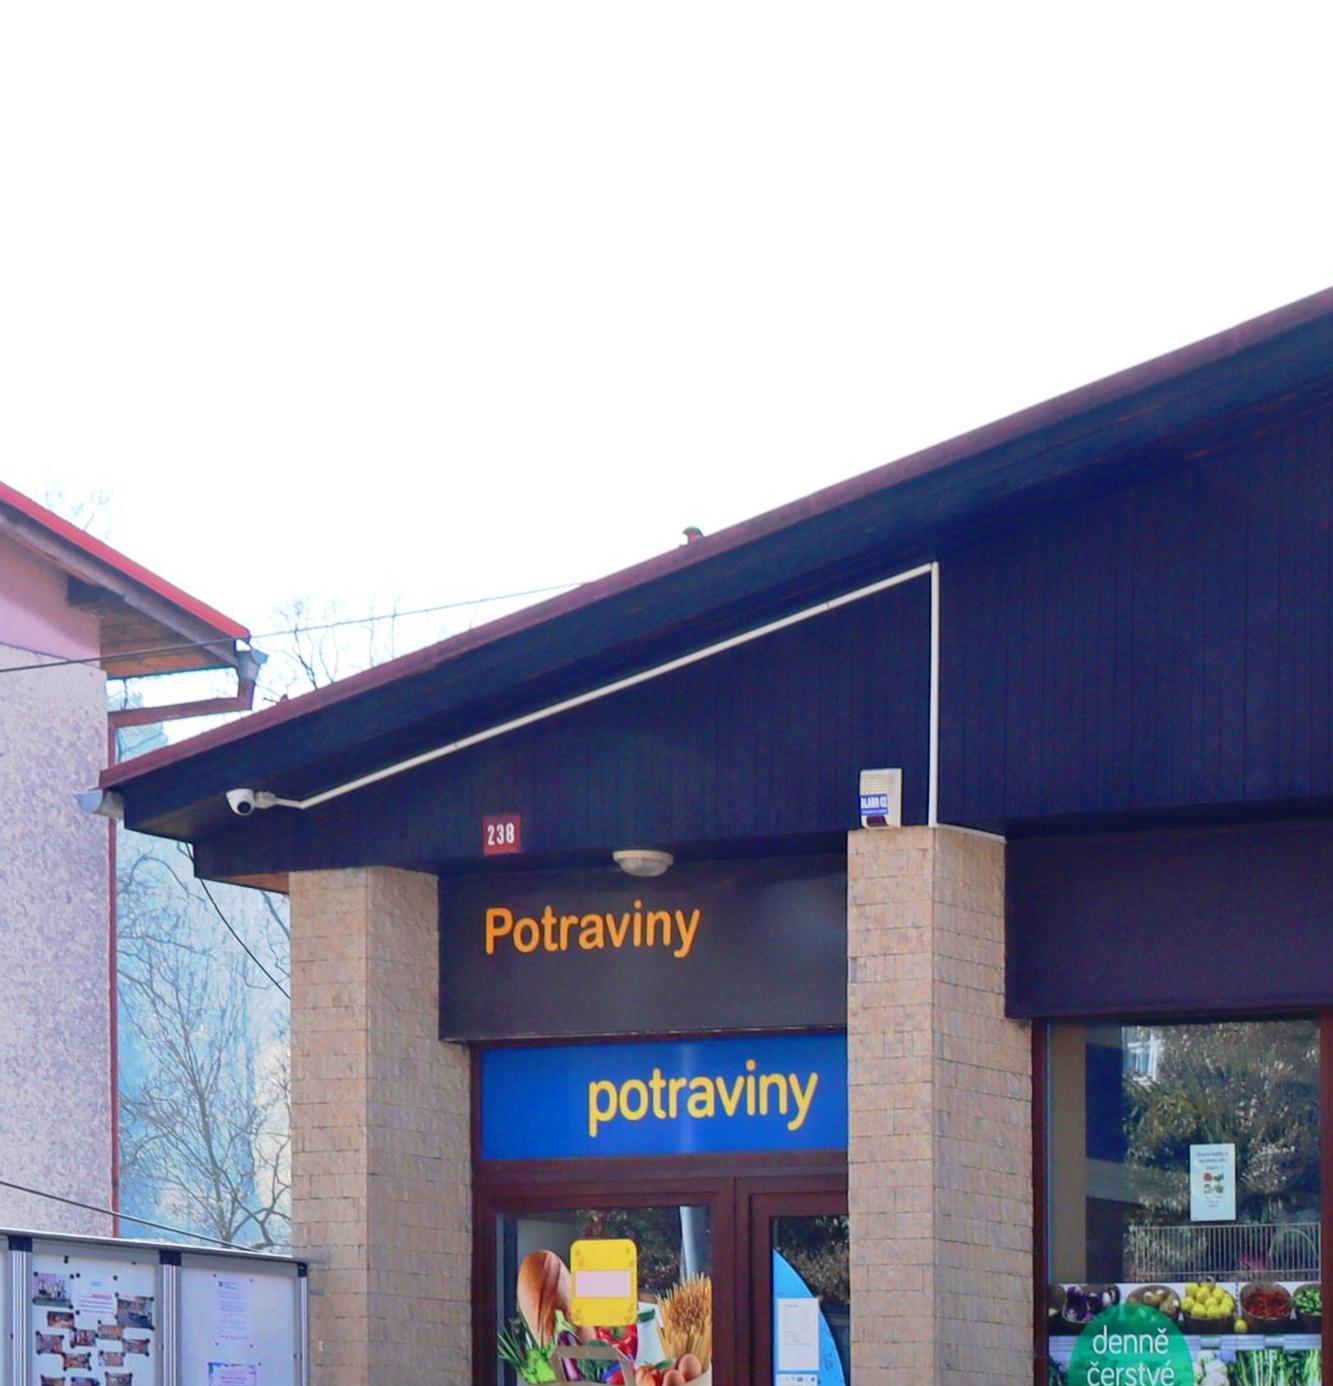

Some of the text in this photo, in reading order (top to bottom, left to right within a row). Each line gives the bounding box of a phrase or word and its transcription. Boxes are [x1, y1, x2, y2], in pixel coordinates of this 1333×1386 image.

[486, 823, 516, 846] 238
[484, 899, 701, 958] Potraviny
[588, 1058, 818, 1138] potraviny
[1092, 1322, 1170, 1357] denně
